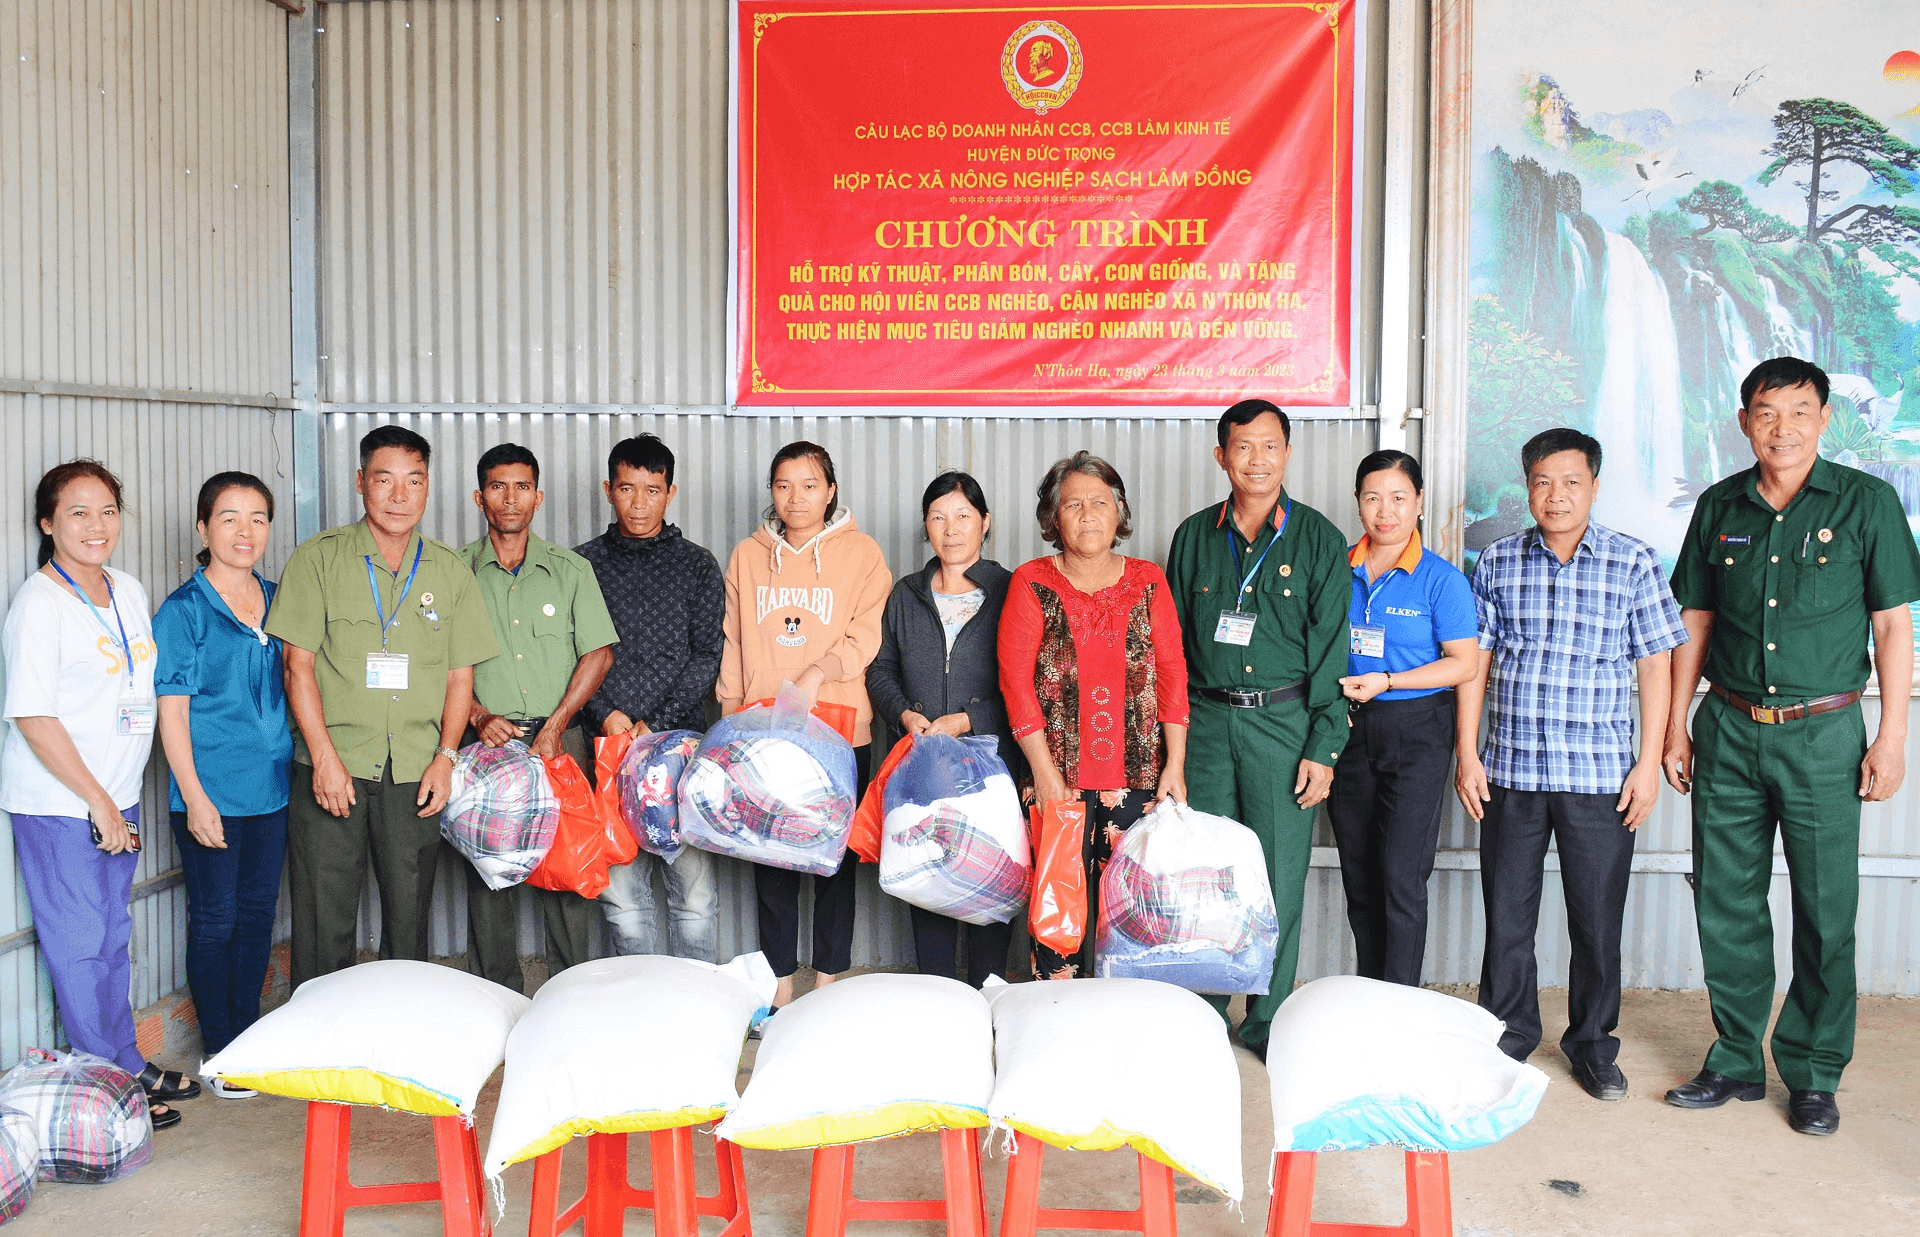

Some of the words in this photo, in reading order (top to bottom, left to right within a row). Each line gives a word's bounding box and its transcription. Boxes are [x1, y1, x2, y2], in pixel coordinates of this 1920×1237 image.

[855, 122, 889, 139] CÂU
[893, 124, 923, 141] LẠC
[927, 121, 947, 141] BỘ
[952, 123, 1006, 138] DOANH
[1010, 120, 1054, 137] NHÂN
[1058, 122, 1095, 138] CCB,
[1100, 122, 1133, 136] CCB
[1137, 118, 1169, 136] LÀM
[1174, 121, 1209, 136] KINH
[1214, 116, 1231, 135] TẾ
[967, 145, 1021, 164] HUYỆN
[1026, 144, 1060, 161] ĐỨC
[1065, 146, 1116, 163] TRỌNG
[833, 171, 871, 193] HỢP
[876, 169, 912, 189] TÁC
[918, 169, 944, 189] XÃ
[950, 169, 1008, 189] NÔNG
[1014, 168, 1085, 191] NGHIỆP
[1090, 170, 1142, 190] SẠCH
[1148, 167, 1188, 187] LÂM
[1194, 164, 1252, 187] ĐỒNG
[875, 213, 1058, 249] CHƯƠNG
[1070, 210, 1208, 247] TRÌNH
[789, 259, 814, 283] HỖ
[819, 263, 853, 286] TRỢ
[858, 261, 881, 283] KỸ
[887, 261, 947, 286] THUẬT,
[953, 261, 1003, 283] PHÂN
[1009, 261, 1053, 284] BÓN,
[1058, 260, 1099, 284] CÂY,
[1105, 263, 1144, 282] CON
[1149, 257, 1212, 283] GIỐNG,
[1218, 259, 1242, 281] VÀ
[1247, 259, 1296, 284] TẶNG
[778, 291, 814, 314] QUÀ
[819, 294, 855, 312] CHO
[860, 291, 891, 315] HỘI
[897, 291, 939, 311] VIÊN
[945, 293, 981, 311] CCB
[988, 290, 1054, 313] NGHÈO,
[1060, 290, 1098, 314] CẬN
[1105, 288, 1166, 310] NGHÈO
[1171, 288, 1197, 309] XÃ
[786, 320, 831, 343] THỰC
[837, 320, 880, 343] HIỆN
[886, 323, 927, 343] MỤC
[933, 319, 973, 340] TIÊU
[978, 318, 1026, 340] GIẢM
[1032, 318, 1094, 339] NGHÈO
[1100, 321, 1164, 339] NHANH
[1170, 317, 1194, 339] VÀ
[1088, 364, 1111, 380] Hạ,
[1115, 362, 1149, 380] ngày
[1152, 363, 1169, 377] 23
[1172, 363, 1212, 379] tháng
[1217, 364, 1226, 377] 3
[1229, 364, 1259, 377] năm
[1263, 363, 1295, 377] 2023
